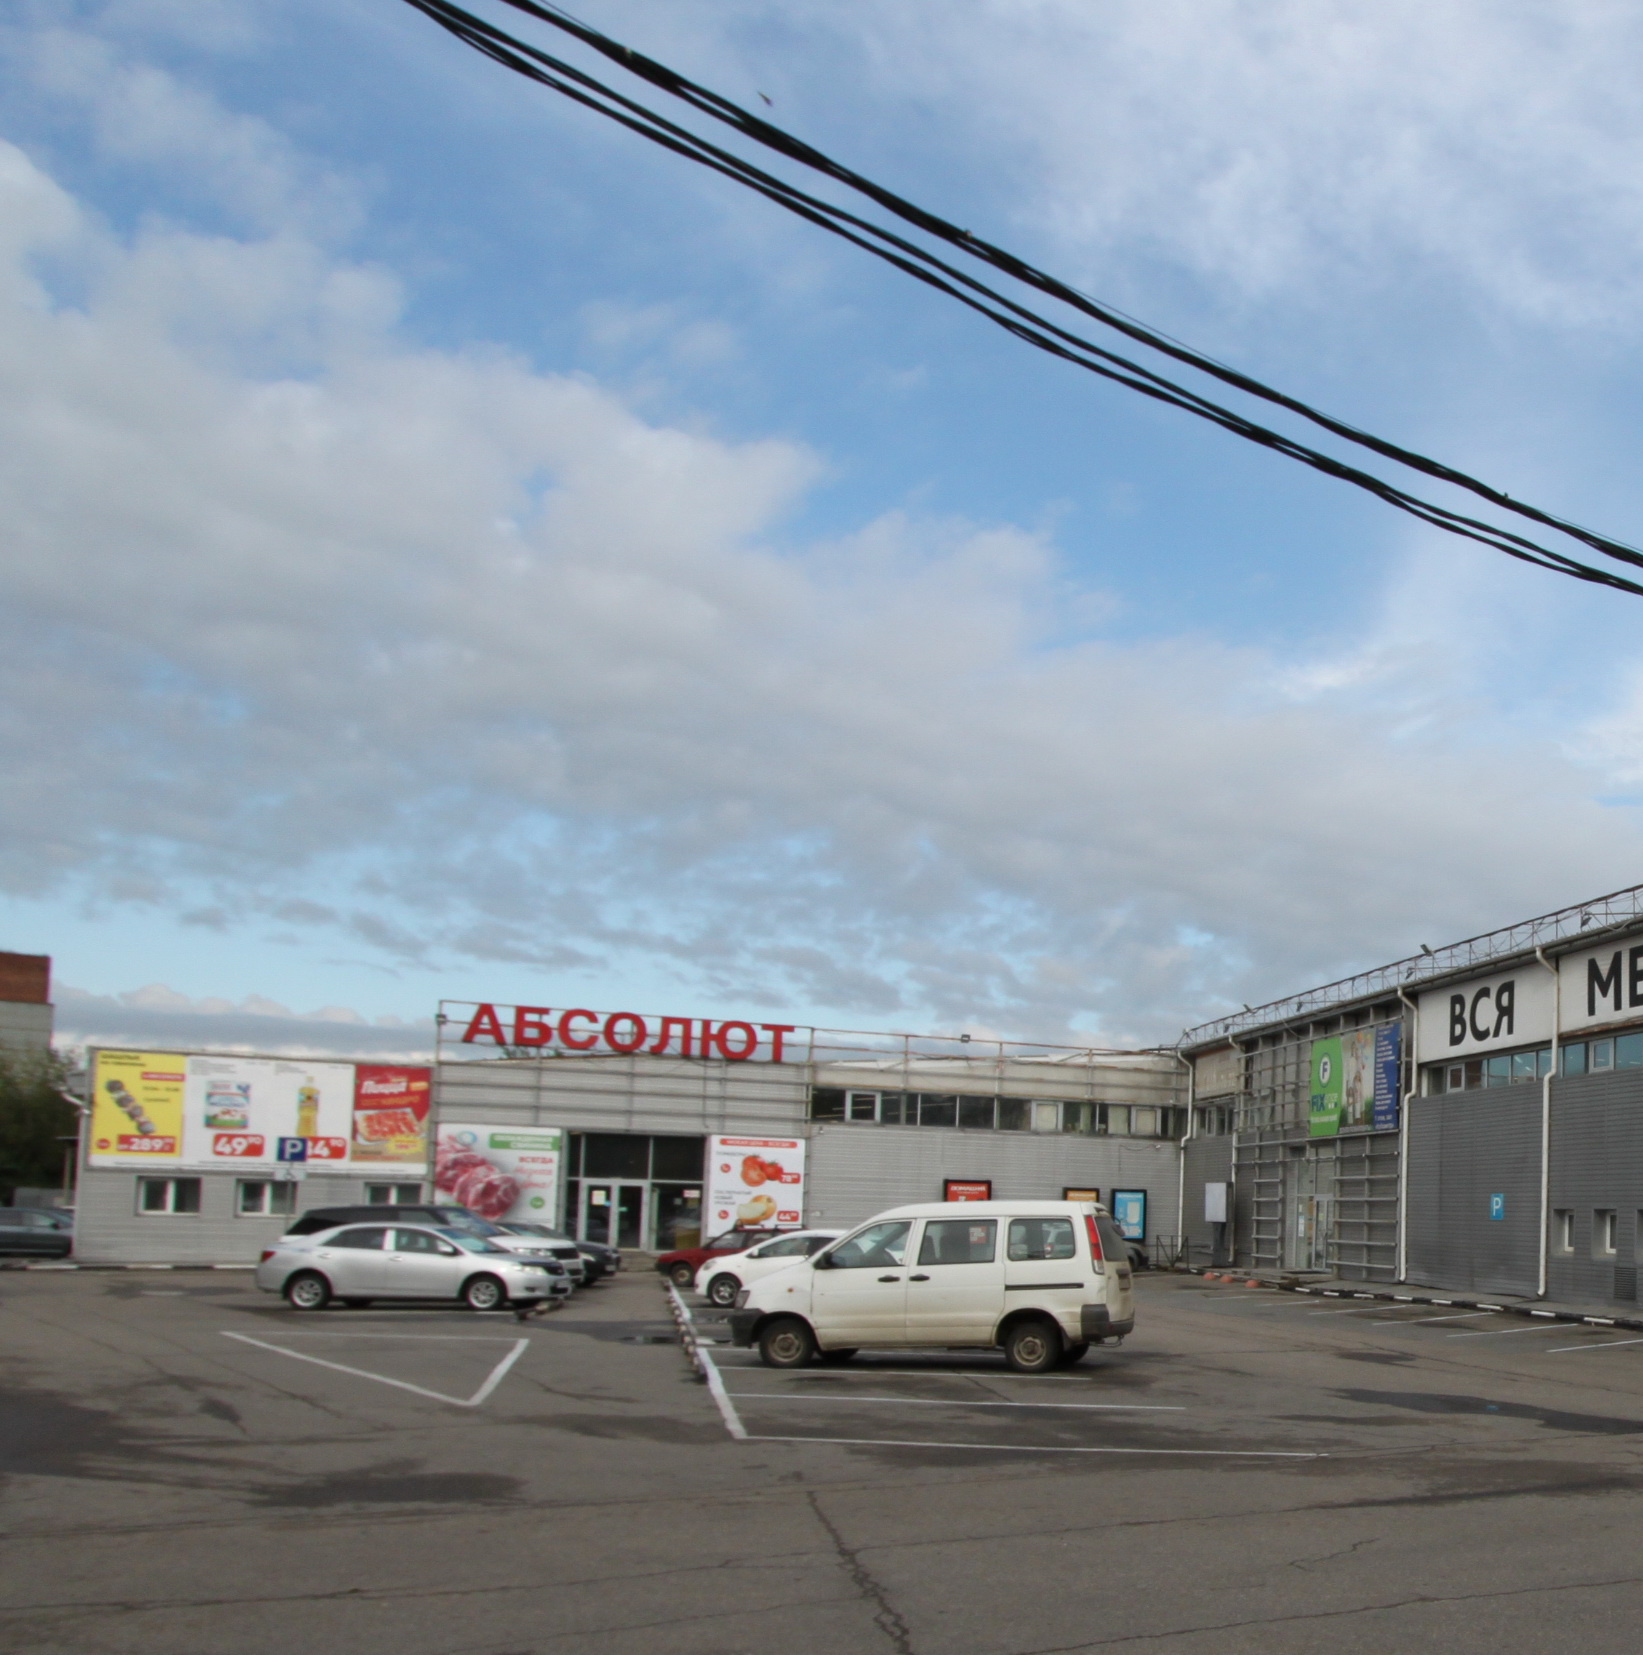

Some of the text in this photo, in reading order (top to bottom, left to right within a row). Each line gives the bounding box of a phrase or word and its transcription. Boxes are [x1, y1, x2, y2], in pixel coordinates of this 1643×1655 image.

[1449, 979, 1515, 1048] ВСЯ
[462, 1003, 795, 1063] АБСОЛЮТ
[215, 1137, 248, 1155] 49
[284, 1139, 303, 1160] P
[1492, 1197, 1502, 1217] P
